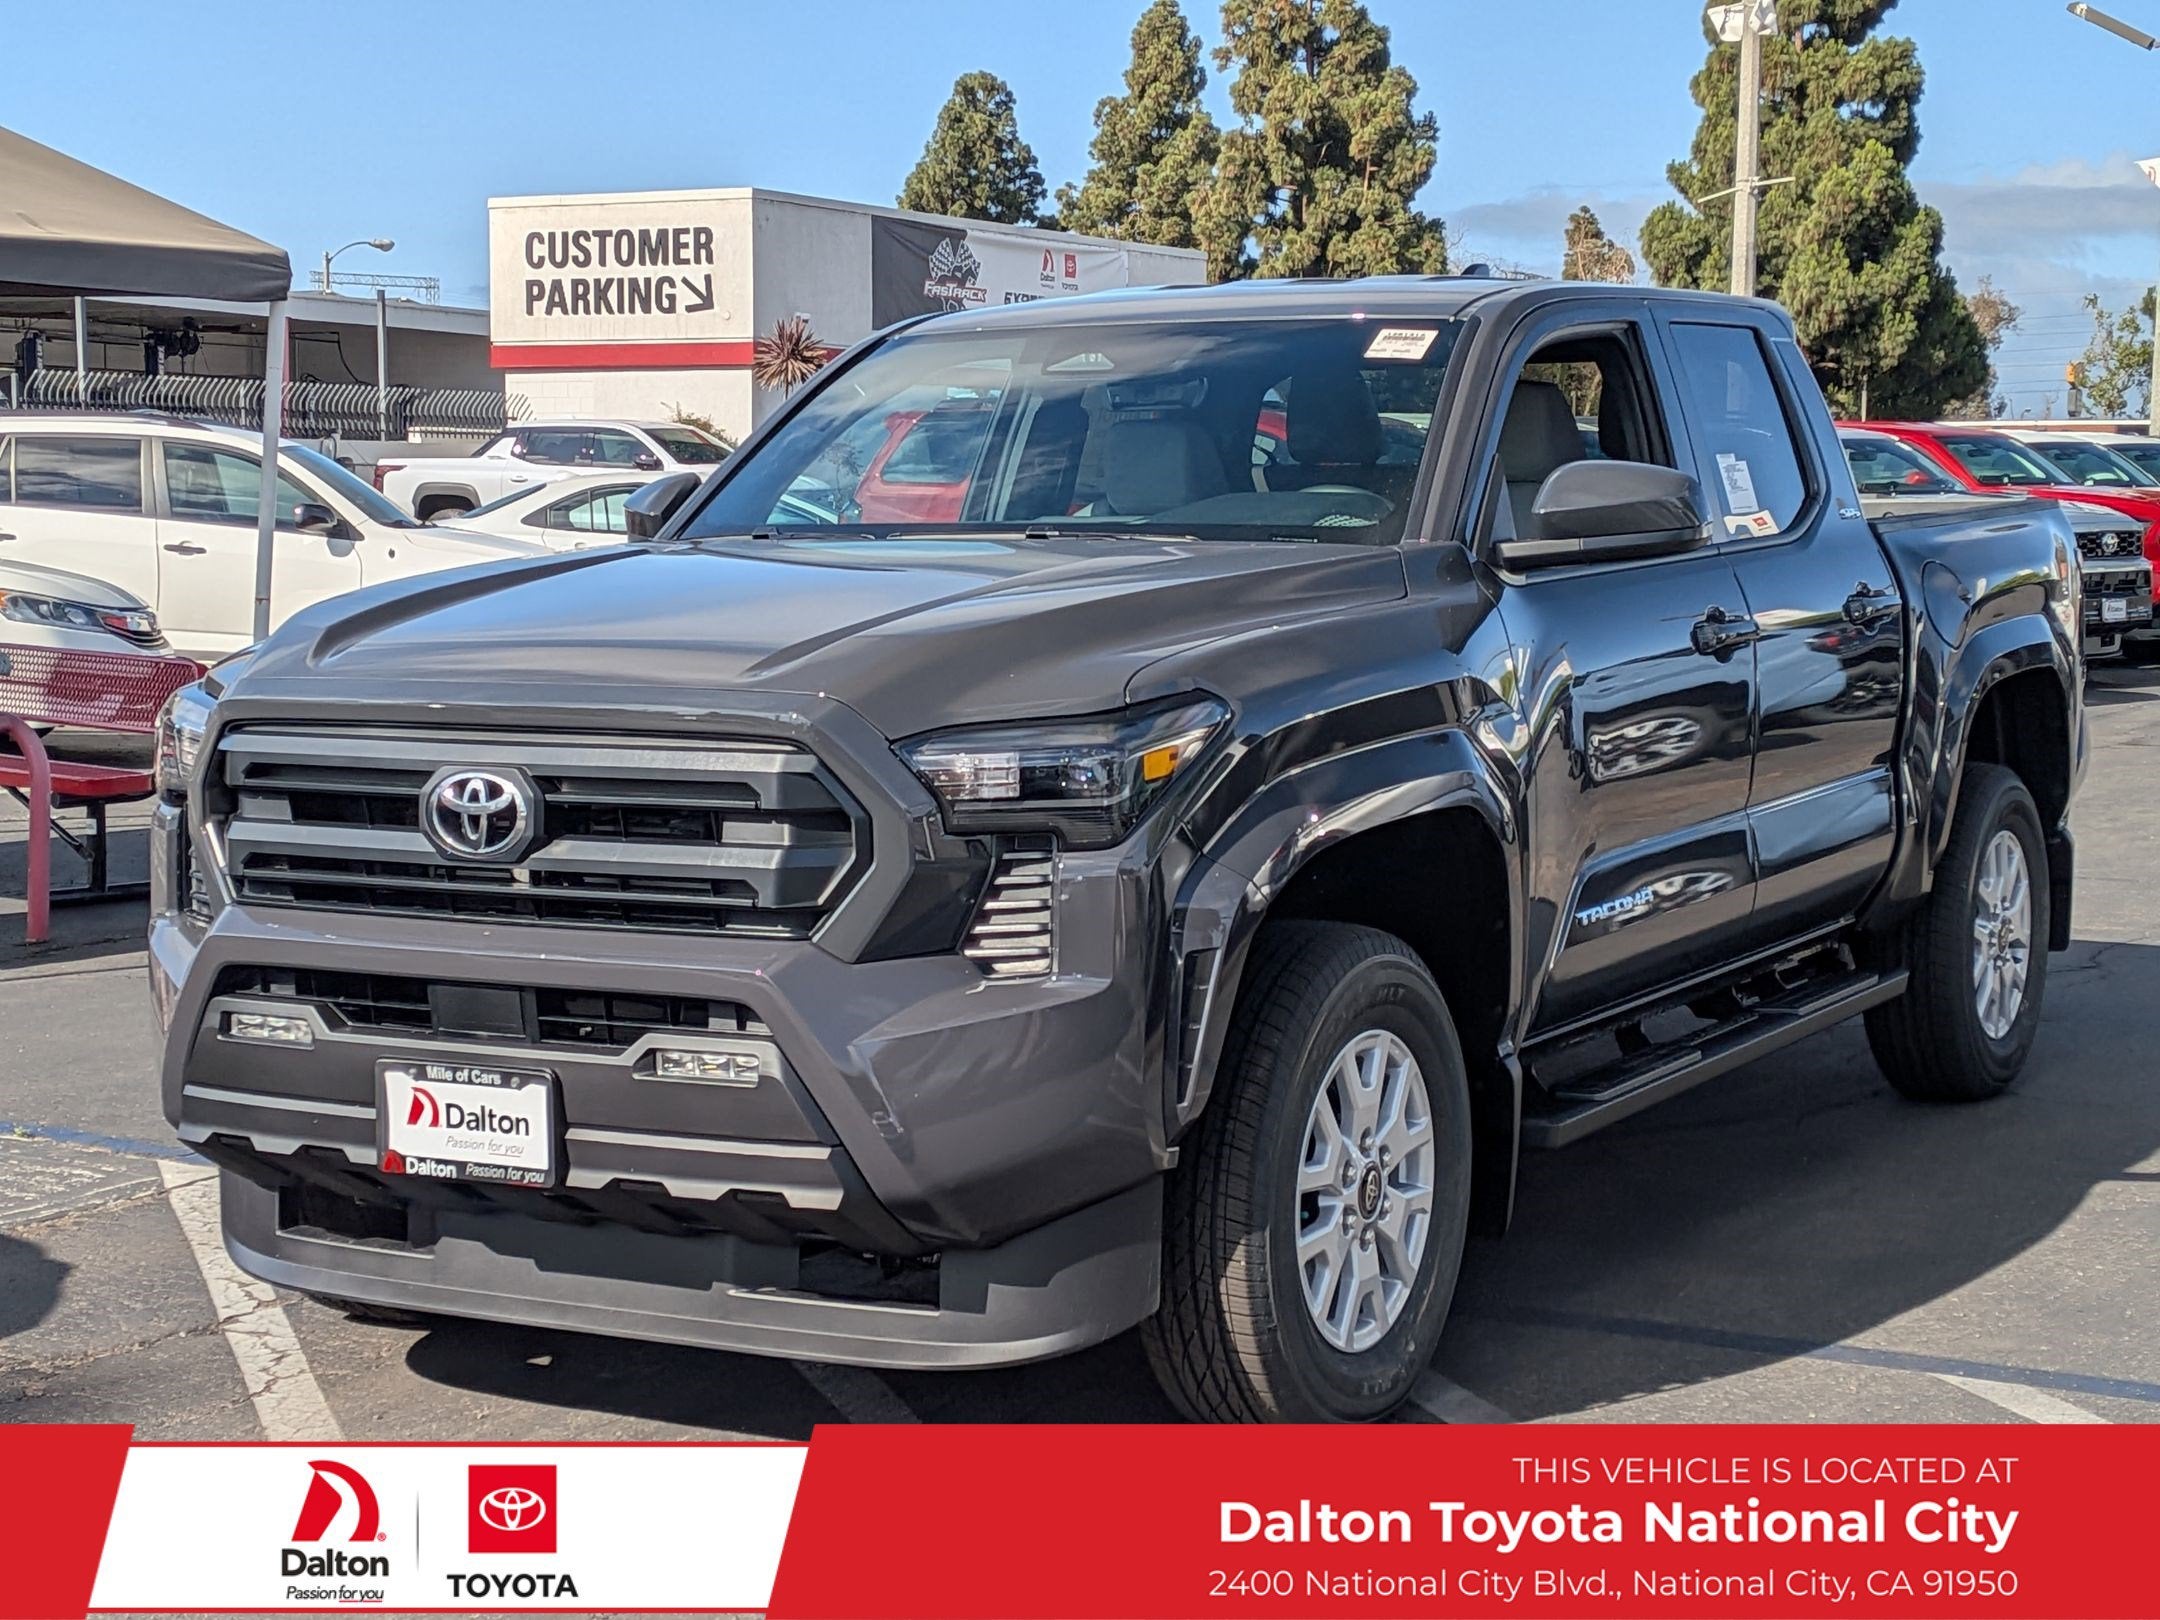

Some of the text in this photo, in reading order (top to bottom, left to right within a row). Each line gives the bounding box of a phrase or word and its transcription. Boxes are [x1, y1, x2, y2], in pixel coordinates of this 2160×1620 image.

[525, 226, 714, 270] CUSTOMER
[525, 275, 678, 316] PARKING
[1574, 886, 1655, 927] TACOMA
[425, 1065, 502, 1085] Mile of Cars
[445, 1102, 530, 1137] Dalton
[446, 1135, 525, 1155] Passion for you
[405, 1156, 458, 1179] Dalton
[465, 1162, 545, 1184] Passion for you
